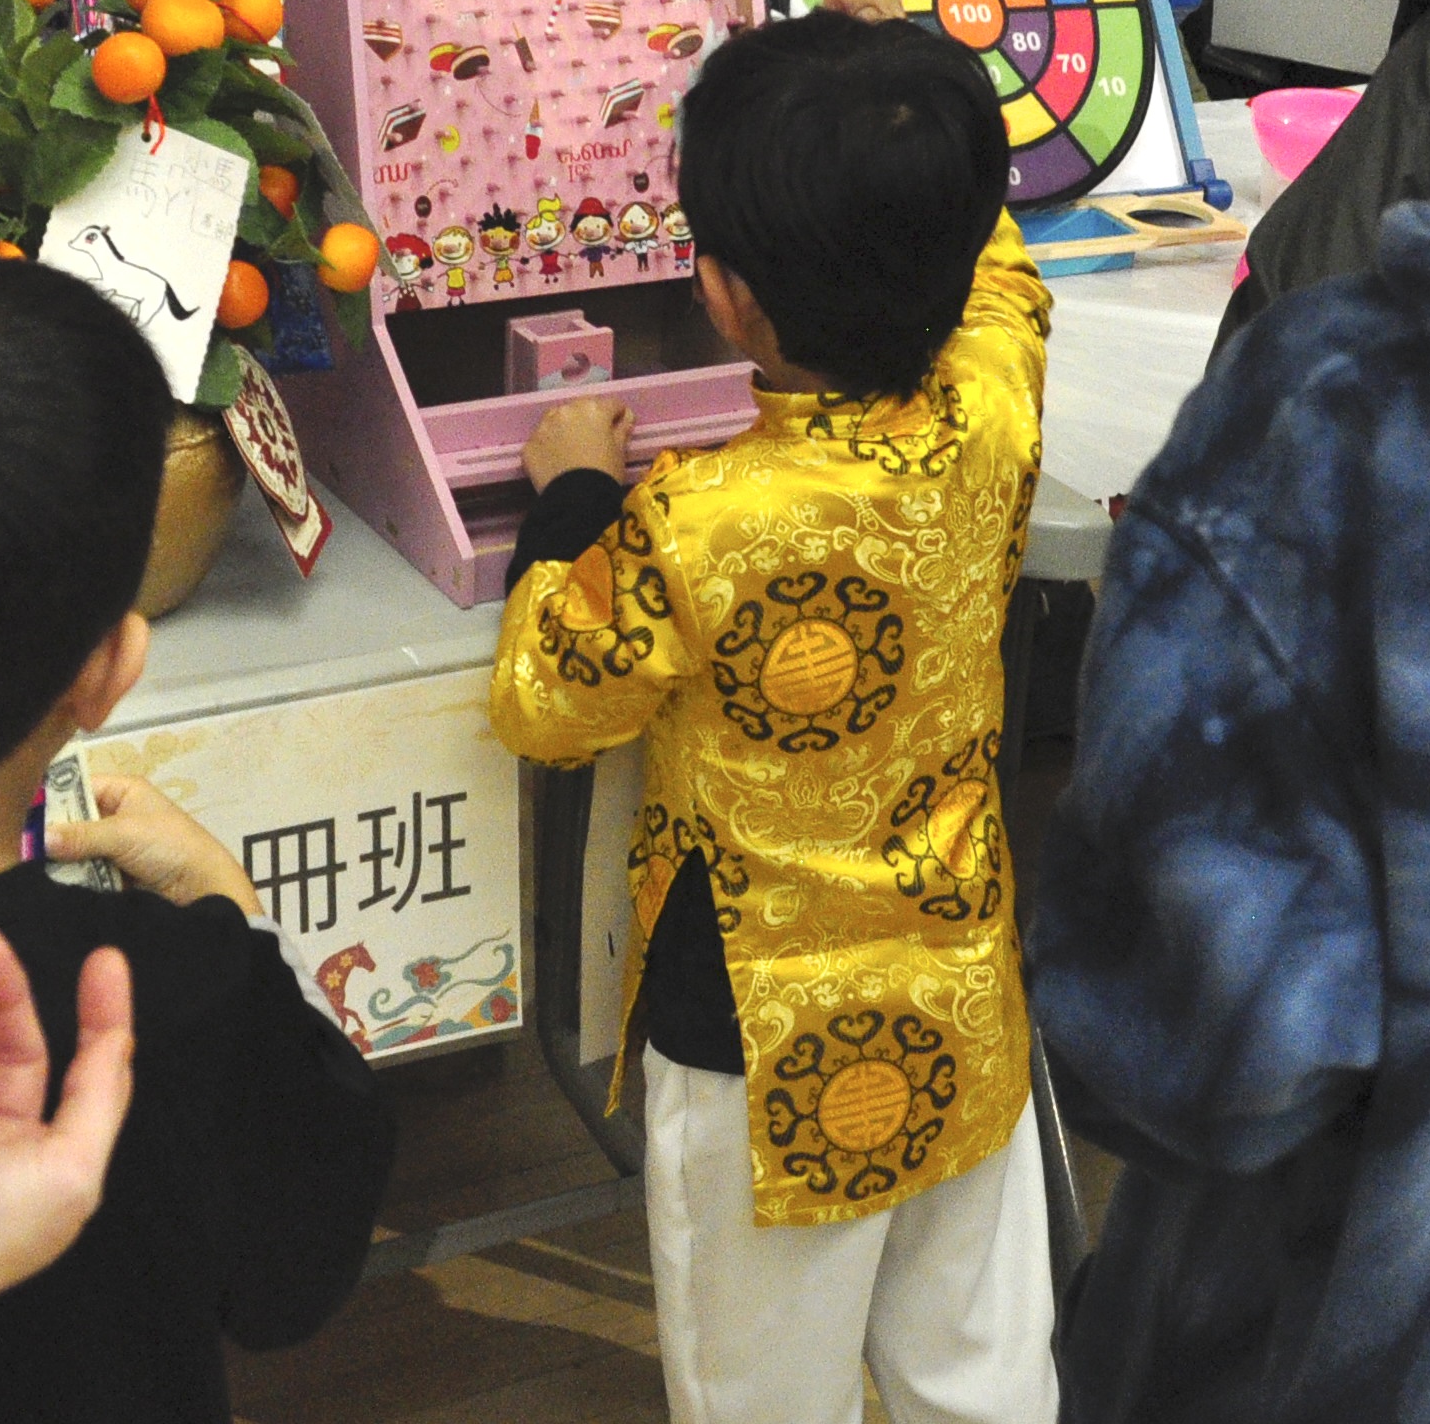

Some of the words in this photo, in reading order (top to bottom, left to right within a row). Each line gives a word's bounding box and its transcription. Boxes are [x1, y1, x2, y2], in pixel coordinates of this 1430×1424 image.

[948, 4, 991, 23] 100
[1012, 32, 1041, 52] 80
[1057, 53, 1085, 73] 70
[1098, 77, 1126, 97] 10
